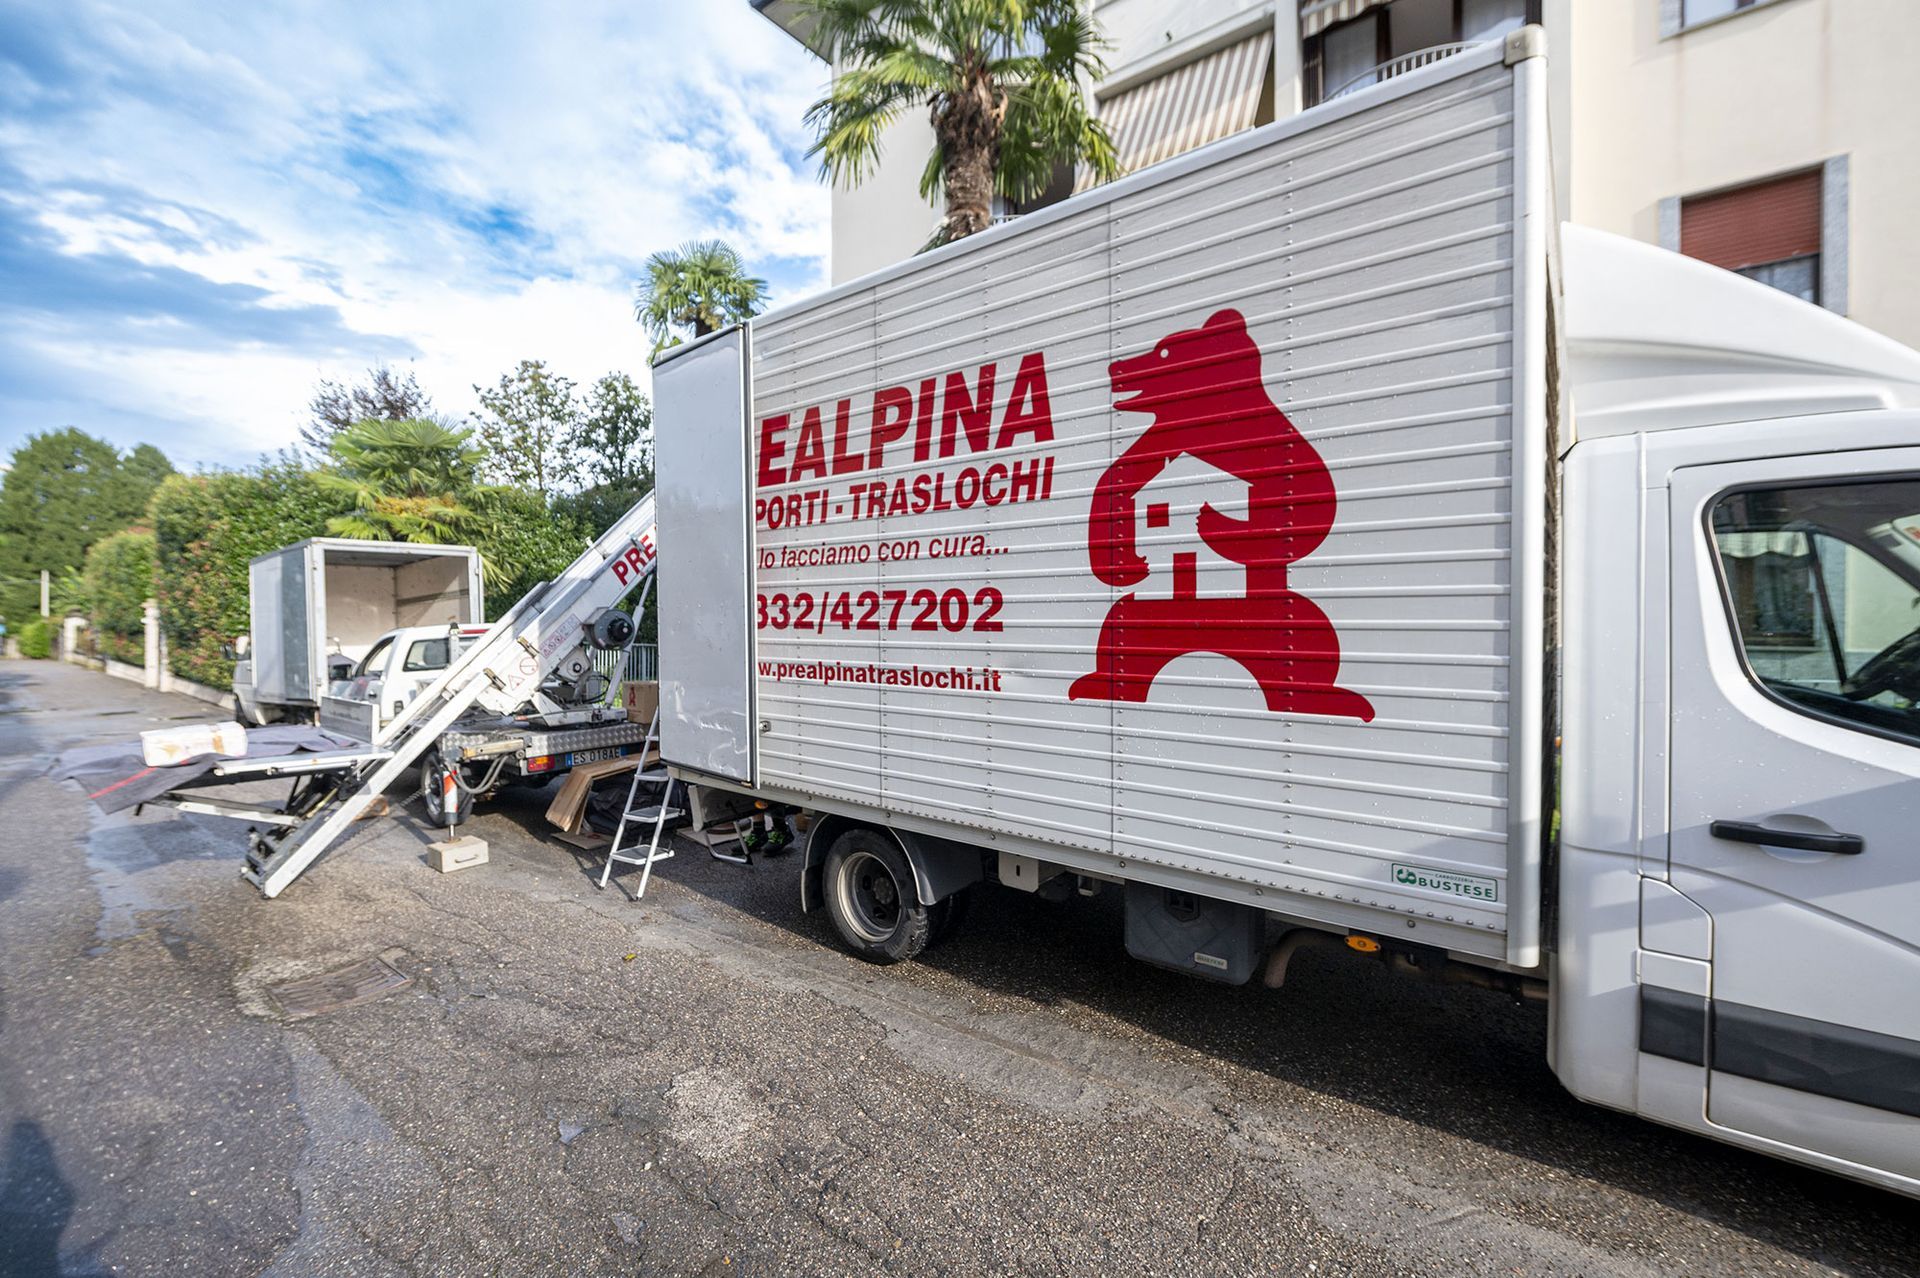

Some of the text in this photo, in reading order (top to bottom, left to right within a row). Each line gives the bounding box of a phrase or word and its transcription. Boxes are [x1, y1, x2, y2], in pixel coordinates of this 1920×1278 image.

[758, 352, 1054, 487] EALPINA
[849, 457, 1055, 519] TRASLOCHI
[611, 526, 657, 587] PRE
[759, 534, 1009, 569] lo facciamo con cura...
[758, 661, 1002, 693] w.prealpinatraslochi.it
[573, 752, 587, 764] ES
[1418, 878, 1493, 897] BUSTESE
